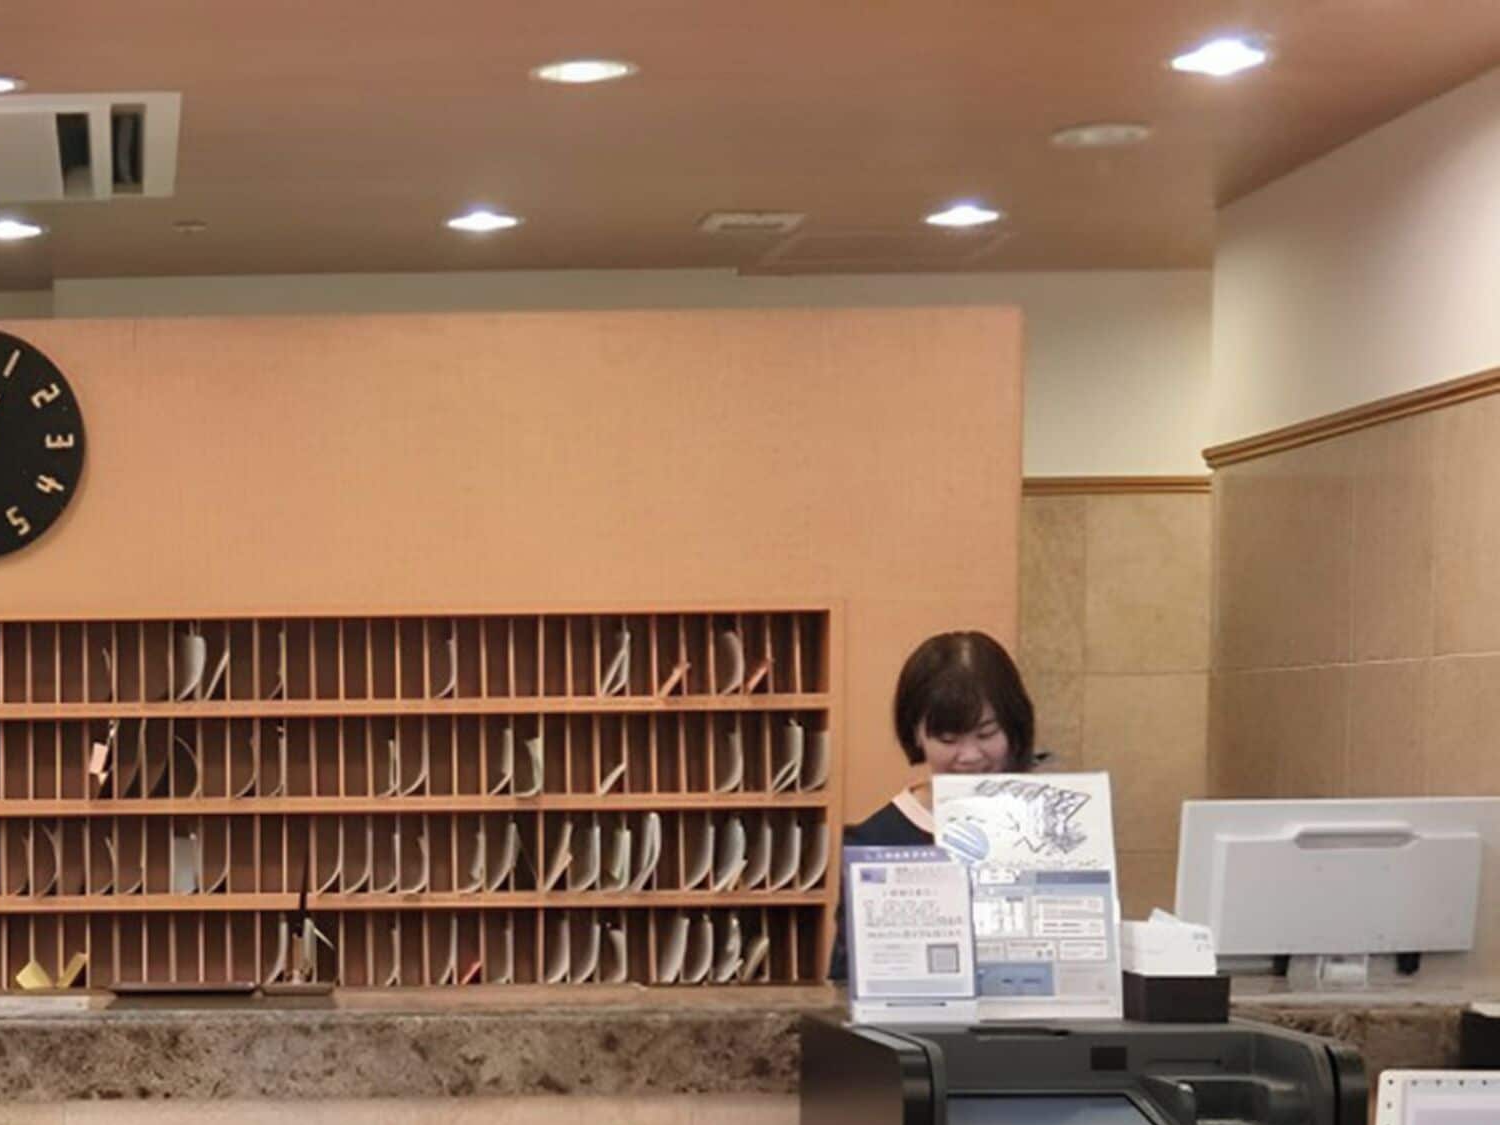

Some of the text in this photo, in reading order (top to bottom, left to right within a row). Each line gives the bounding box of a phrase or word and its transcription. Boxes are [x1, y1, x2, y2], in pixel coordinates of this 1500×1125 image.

[3, 349, 21, 377] 1
[30, 383, 61, 408] 2
[45, 433, 74, 449] 3
[35, 474, 65, 493] 4
[5, 506, 31, 537] 5
